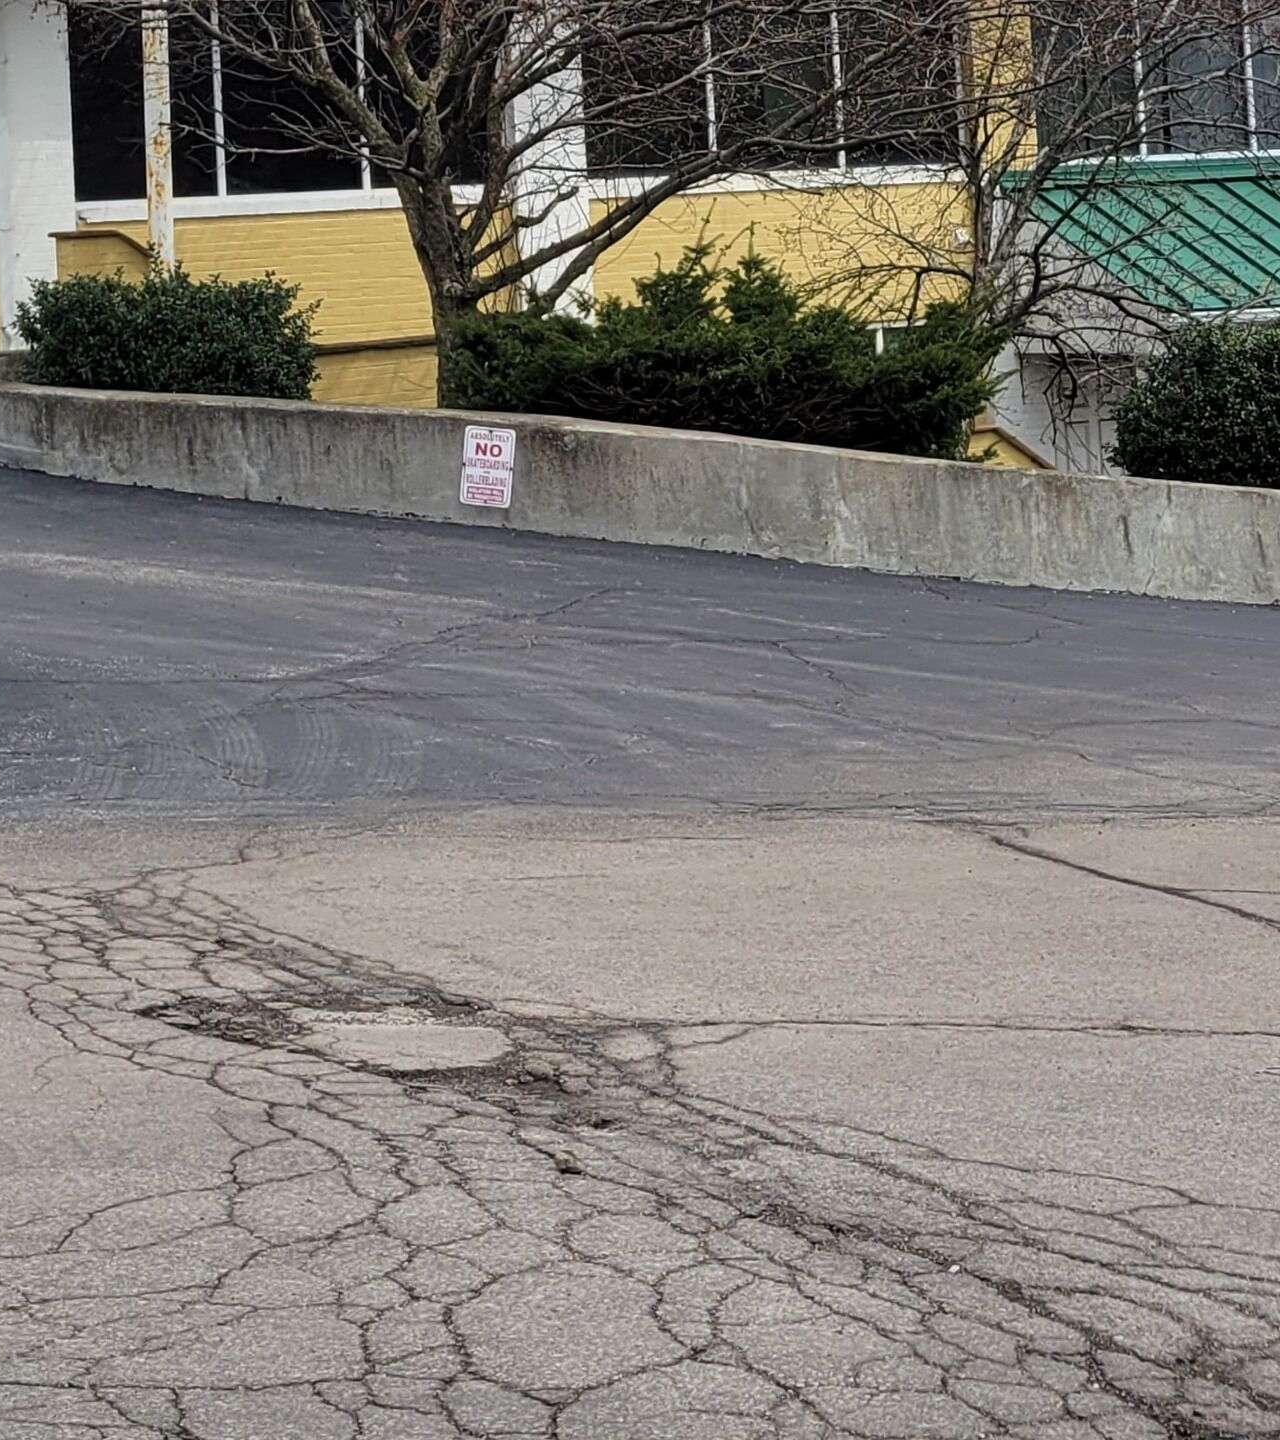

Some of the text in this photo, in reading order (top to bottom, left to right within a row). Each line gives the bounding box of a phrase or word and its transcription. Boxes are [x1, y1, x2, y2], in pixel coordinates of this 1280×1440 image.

[470, 432, 510, 443] ABSOLUTELY
[475, 442, 502, 457] NO
[467, 458, 509, 471] SKATEBOARDING
